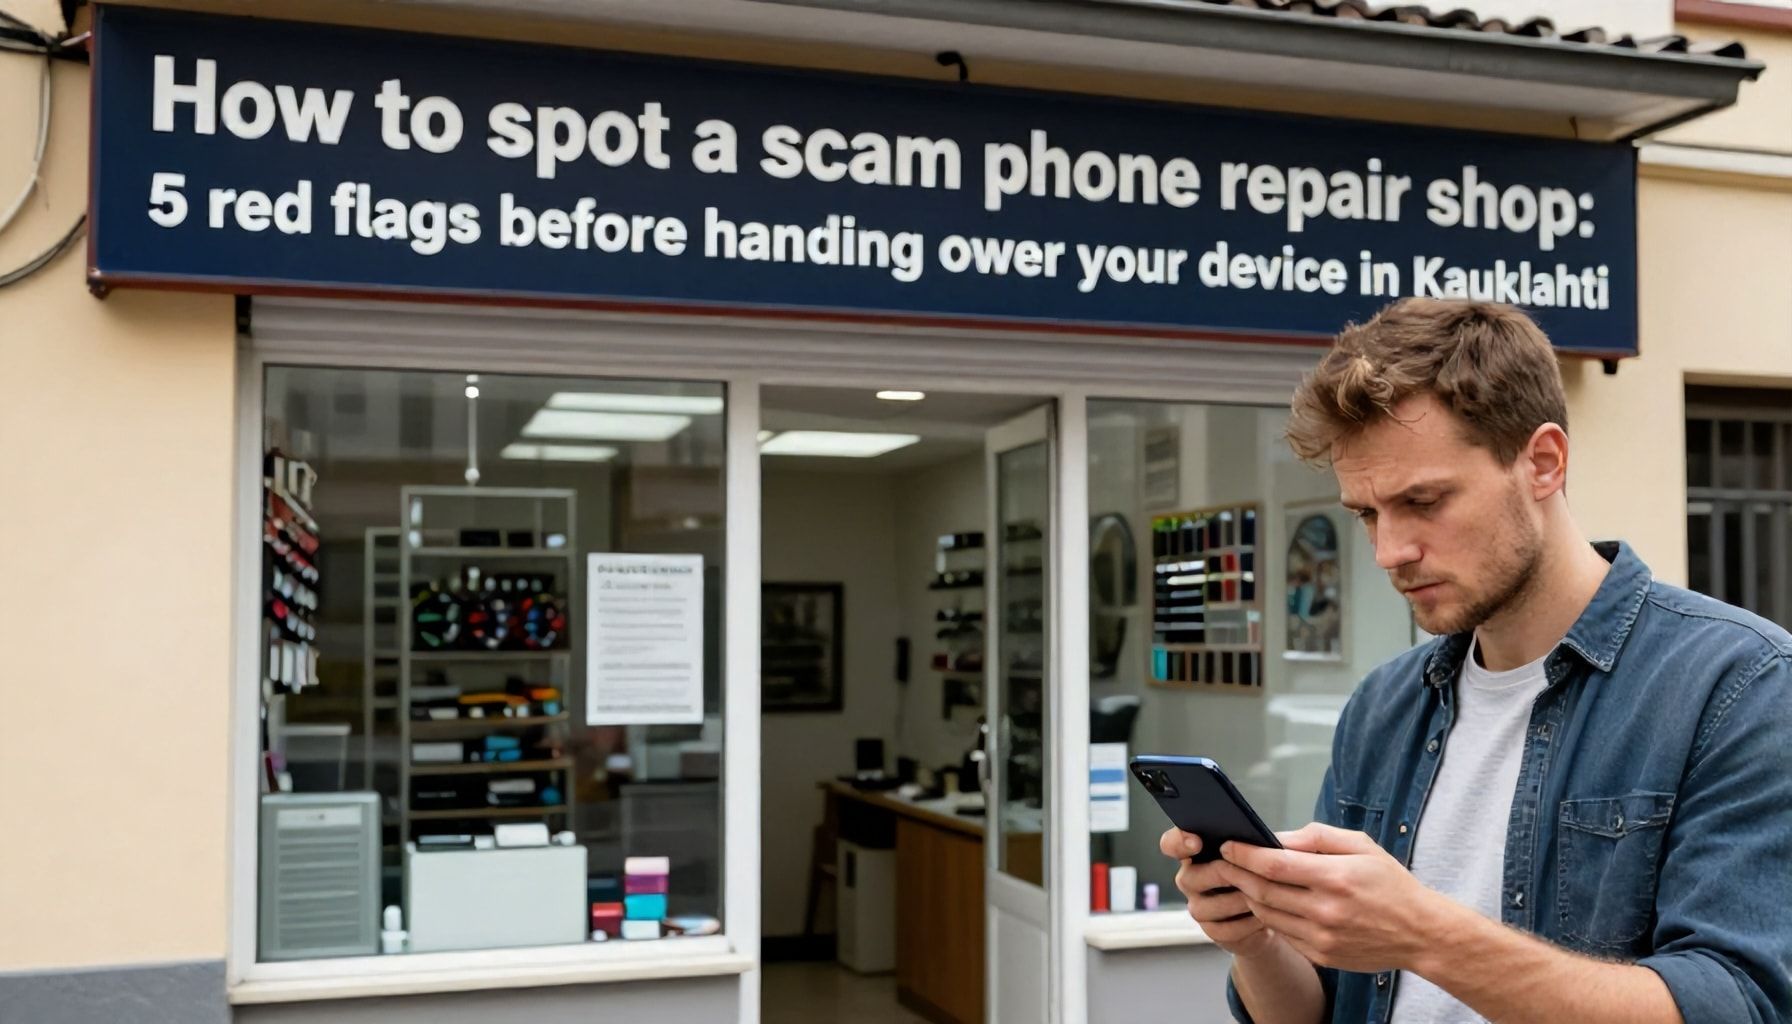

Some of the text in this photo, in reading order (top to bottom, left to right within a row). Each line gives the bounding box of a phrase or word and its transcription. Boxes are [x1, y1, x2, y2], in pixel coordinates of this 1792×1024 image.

[153, 55, 1595, 251] How to spot a scam phone repair shop:
[148, 172, 1609, 310] 5 red flags before handing ower your device in Kauklahti
